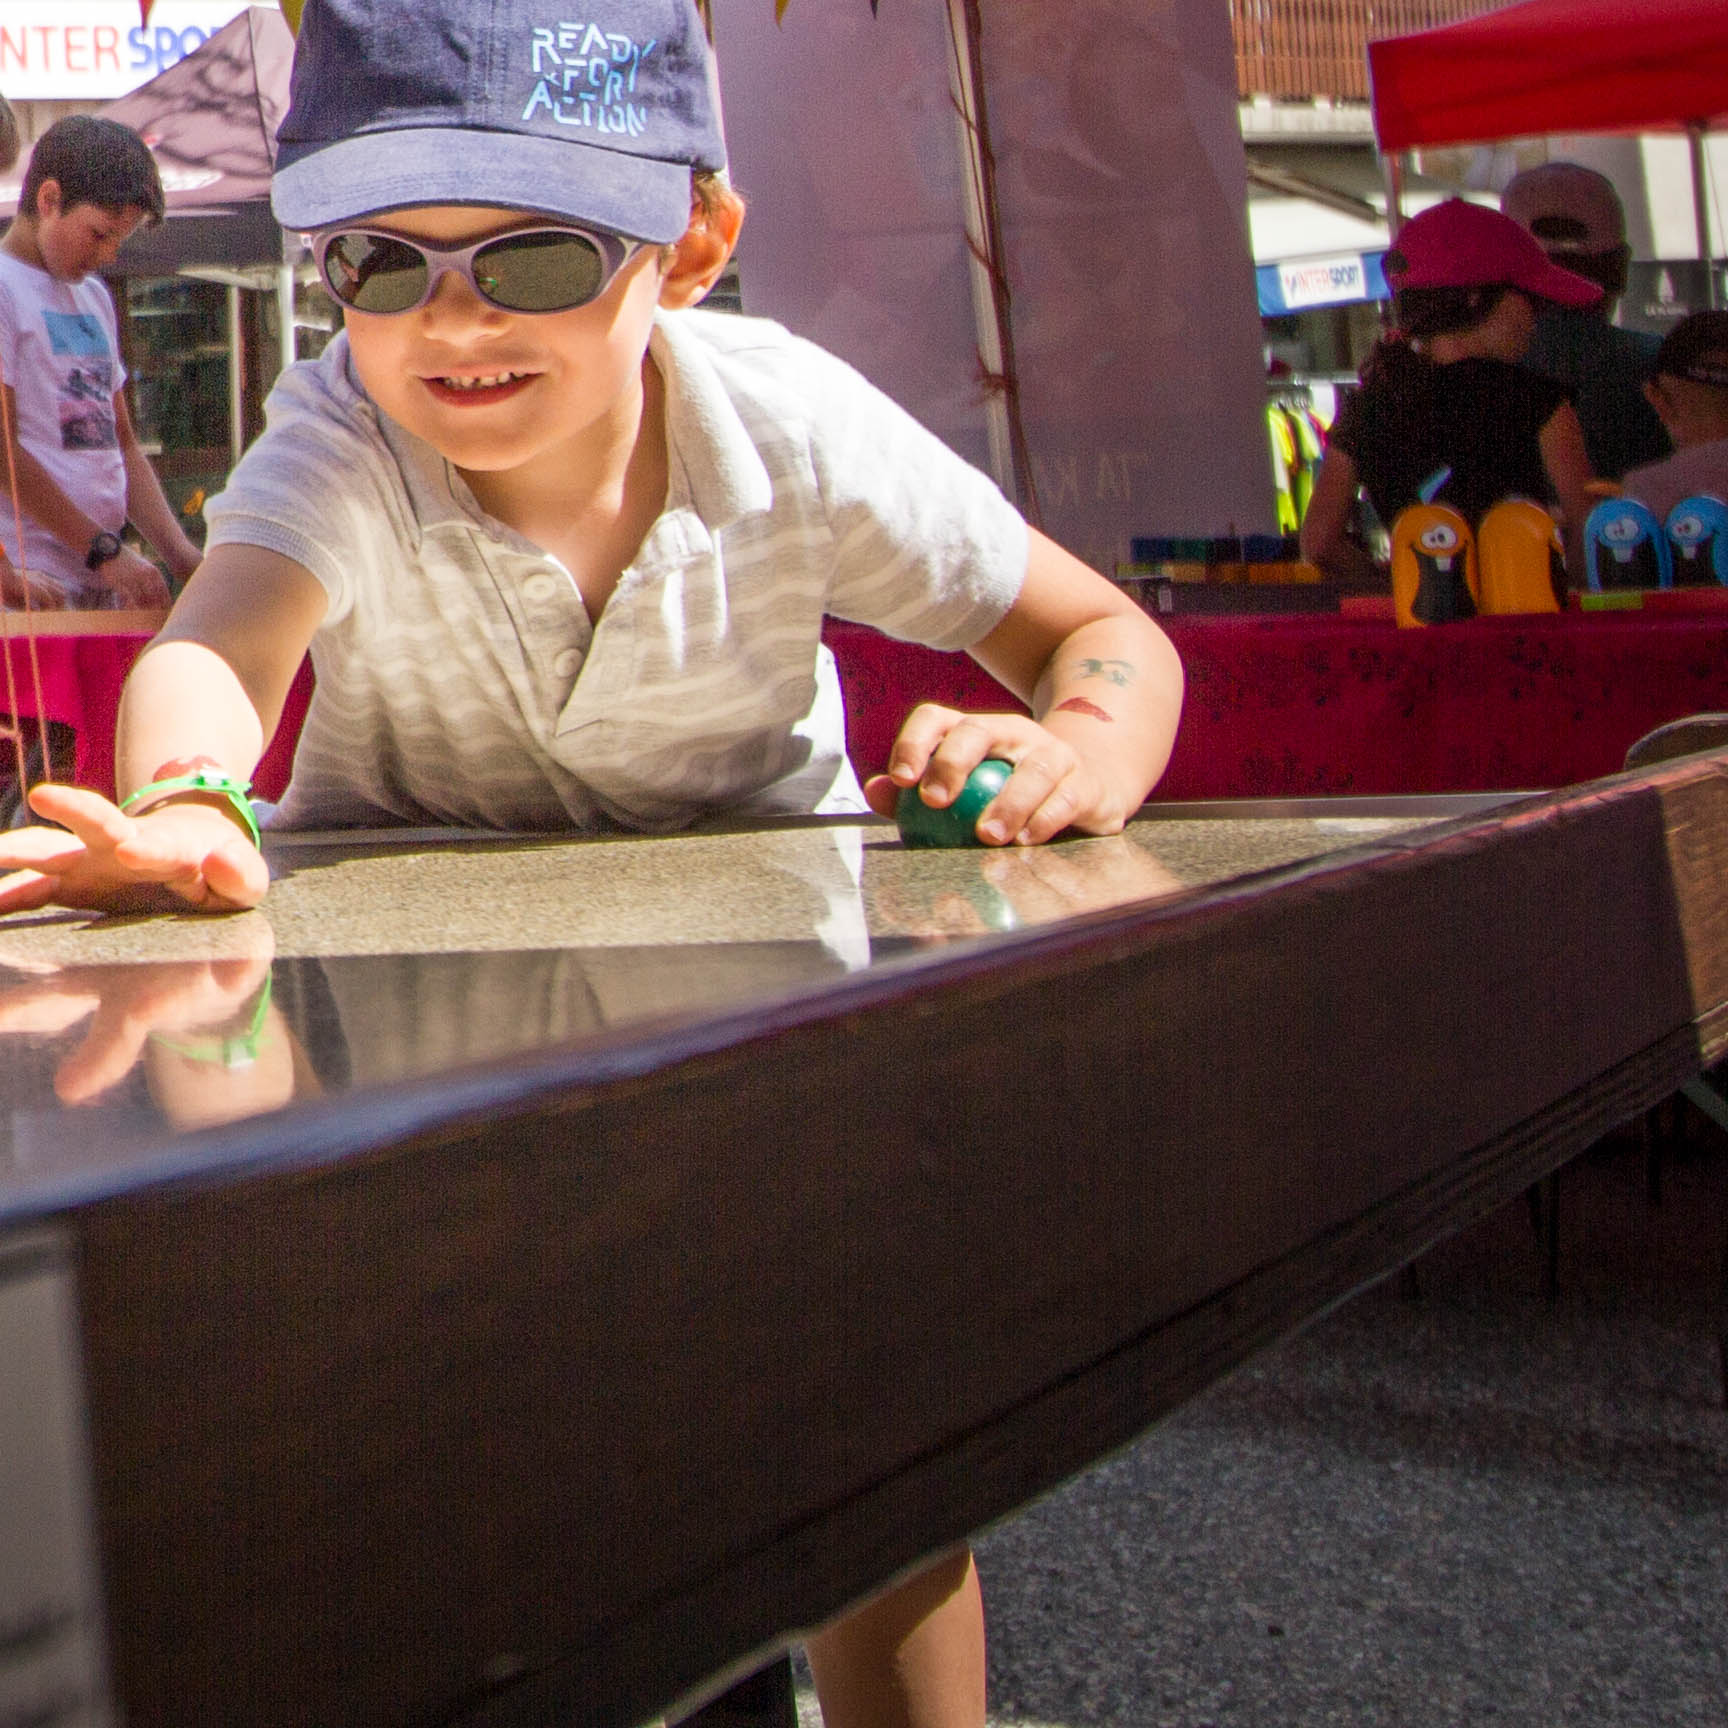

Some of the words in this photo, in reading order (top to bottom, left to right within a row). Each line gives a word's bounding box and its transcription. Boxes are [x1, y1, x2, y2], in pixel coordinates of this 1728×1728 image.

[530, 21, 658, 94] READY
[562, 56, 625, 107] FOR
[521, 78, 649, 139] ACTION
